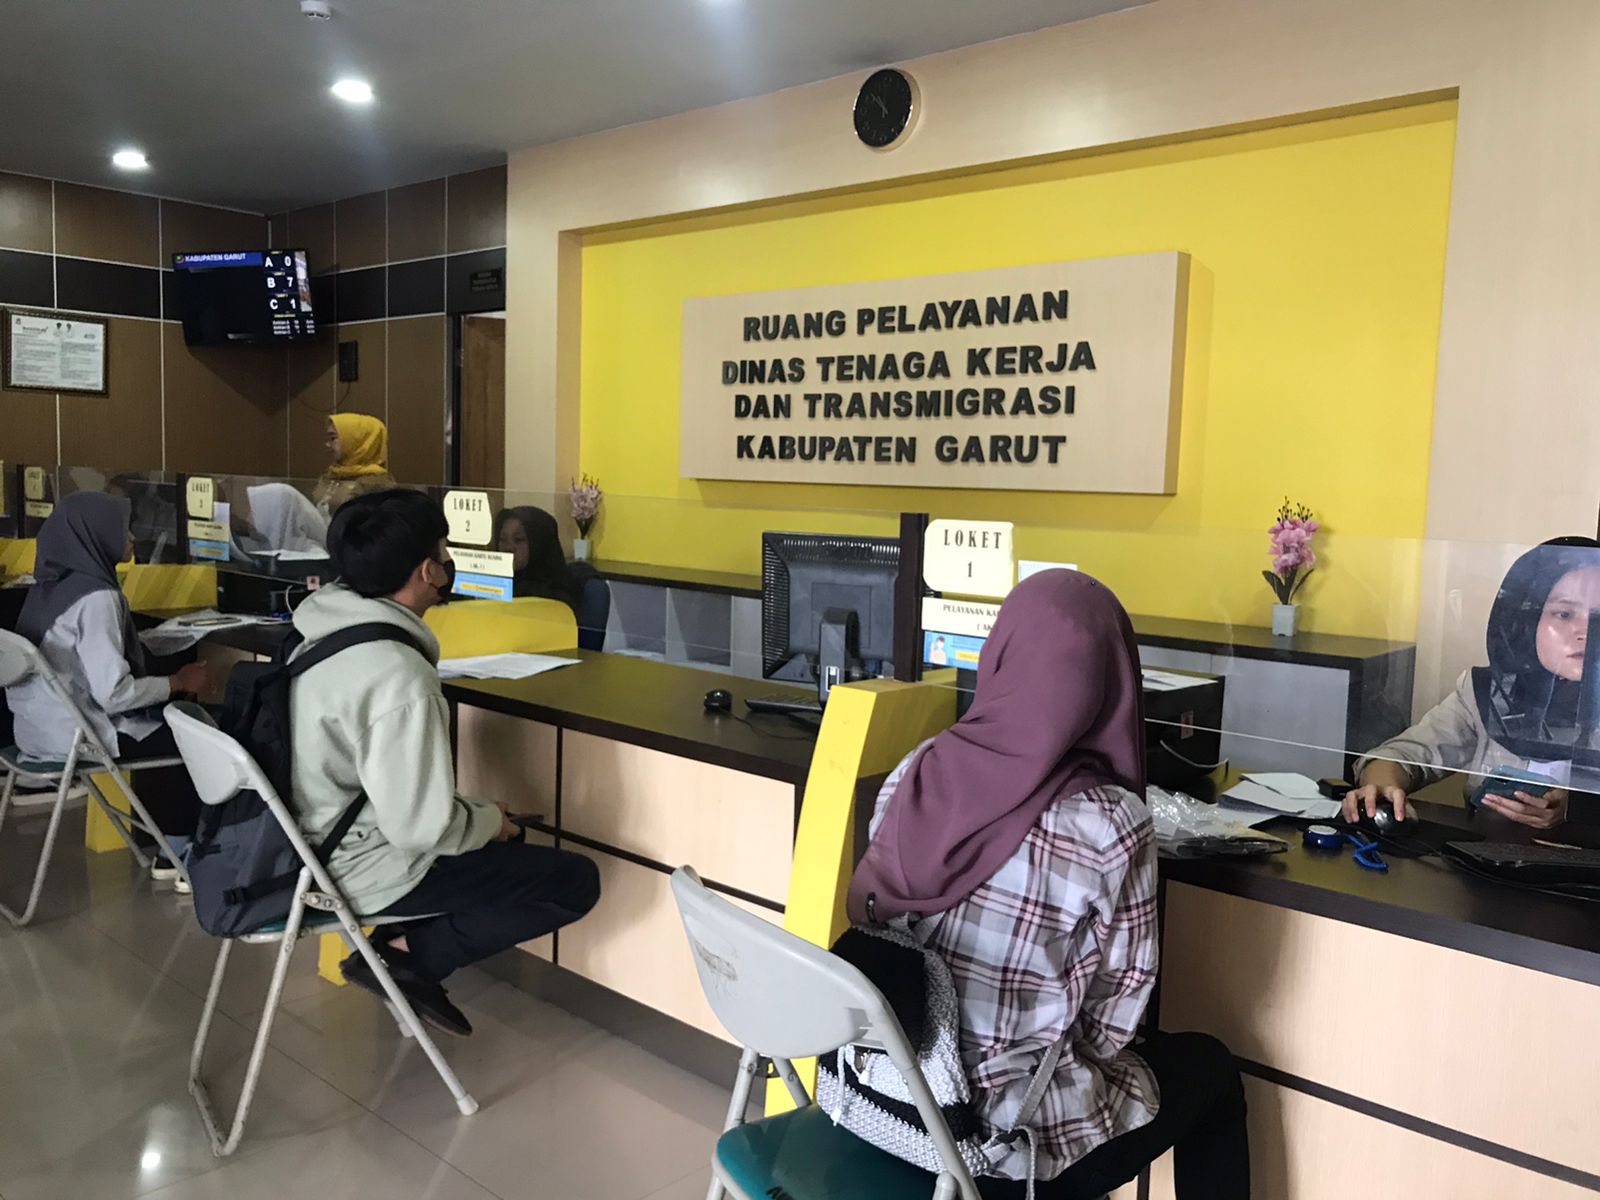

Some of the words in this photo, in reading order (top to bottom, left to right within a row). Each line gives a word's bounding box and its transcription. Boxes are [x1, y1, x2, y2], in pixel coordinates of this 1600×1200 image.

[265, 256, 274, 268] A
[267, 277, 276, 288] B
[286, 276, 294, 288] 7
[269, 299, 279, 310] C
[290, 299, 297, 309] 1
[743, 310, 847, 342] RUANG
[856, 289, 1069, 336] PELAYANAN
[721, 357, 806, 385] DINAS
[816, 350, 951, 382] TENAGA
[966, 340, 1097, 376] KERJA
[734, 393, 792, 419] DAN
[803, 385, 1076, 419] TRANSMIGRASI
[736, 434, 917, 463] KABUPATEN
[934, 434, 1067, 464] GARUT
[453, 498, 483, 512] LOKET
[465, 520, 471, 532] 2
[944, 529, 1002, 549] LOKET
[967, 561, 973, 577] 1
[943, 604, 984, 616] PELAYANAN
[986, 608, 998, 617] KA
